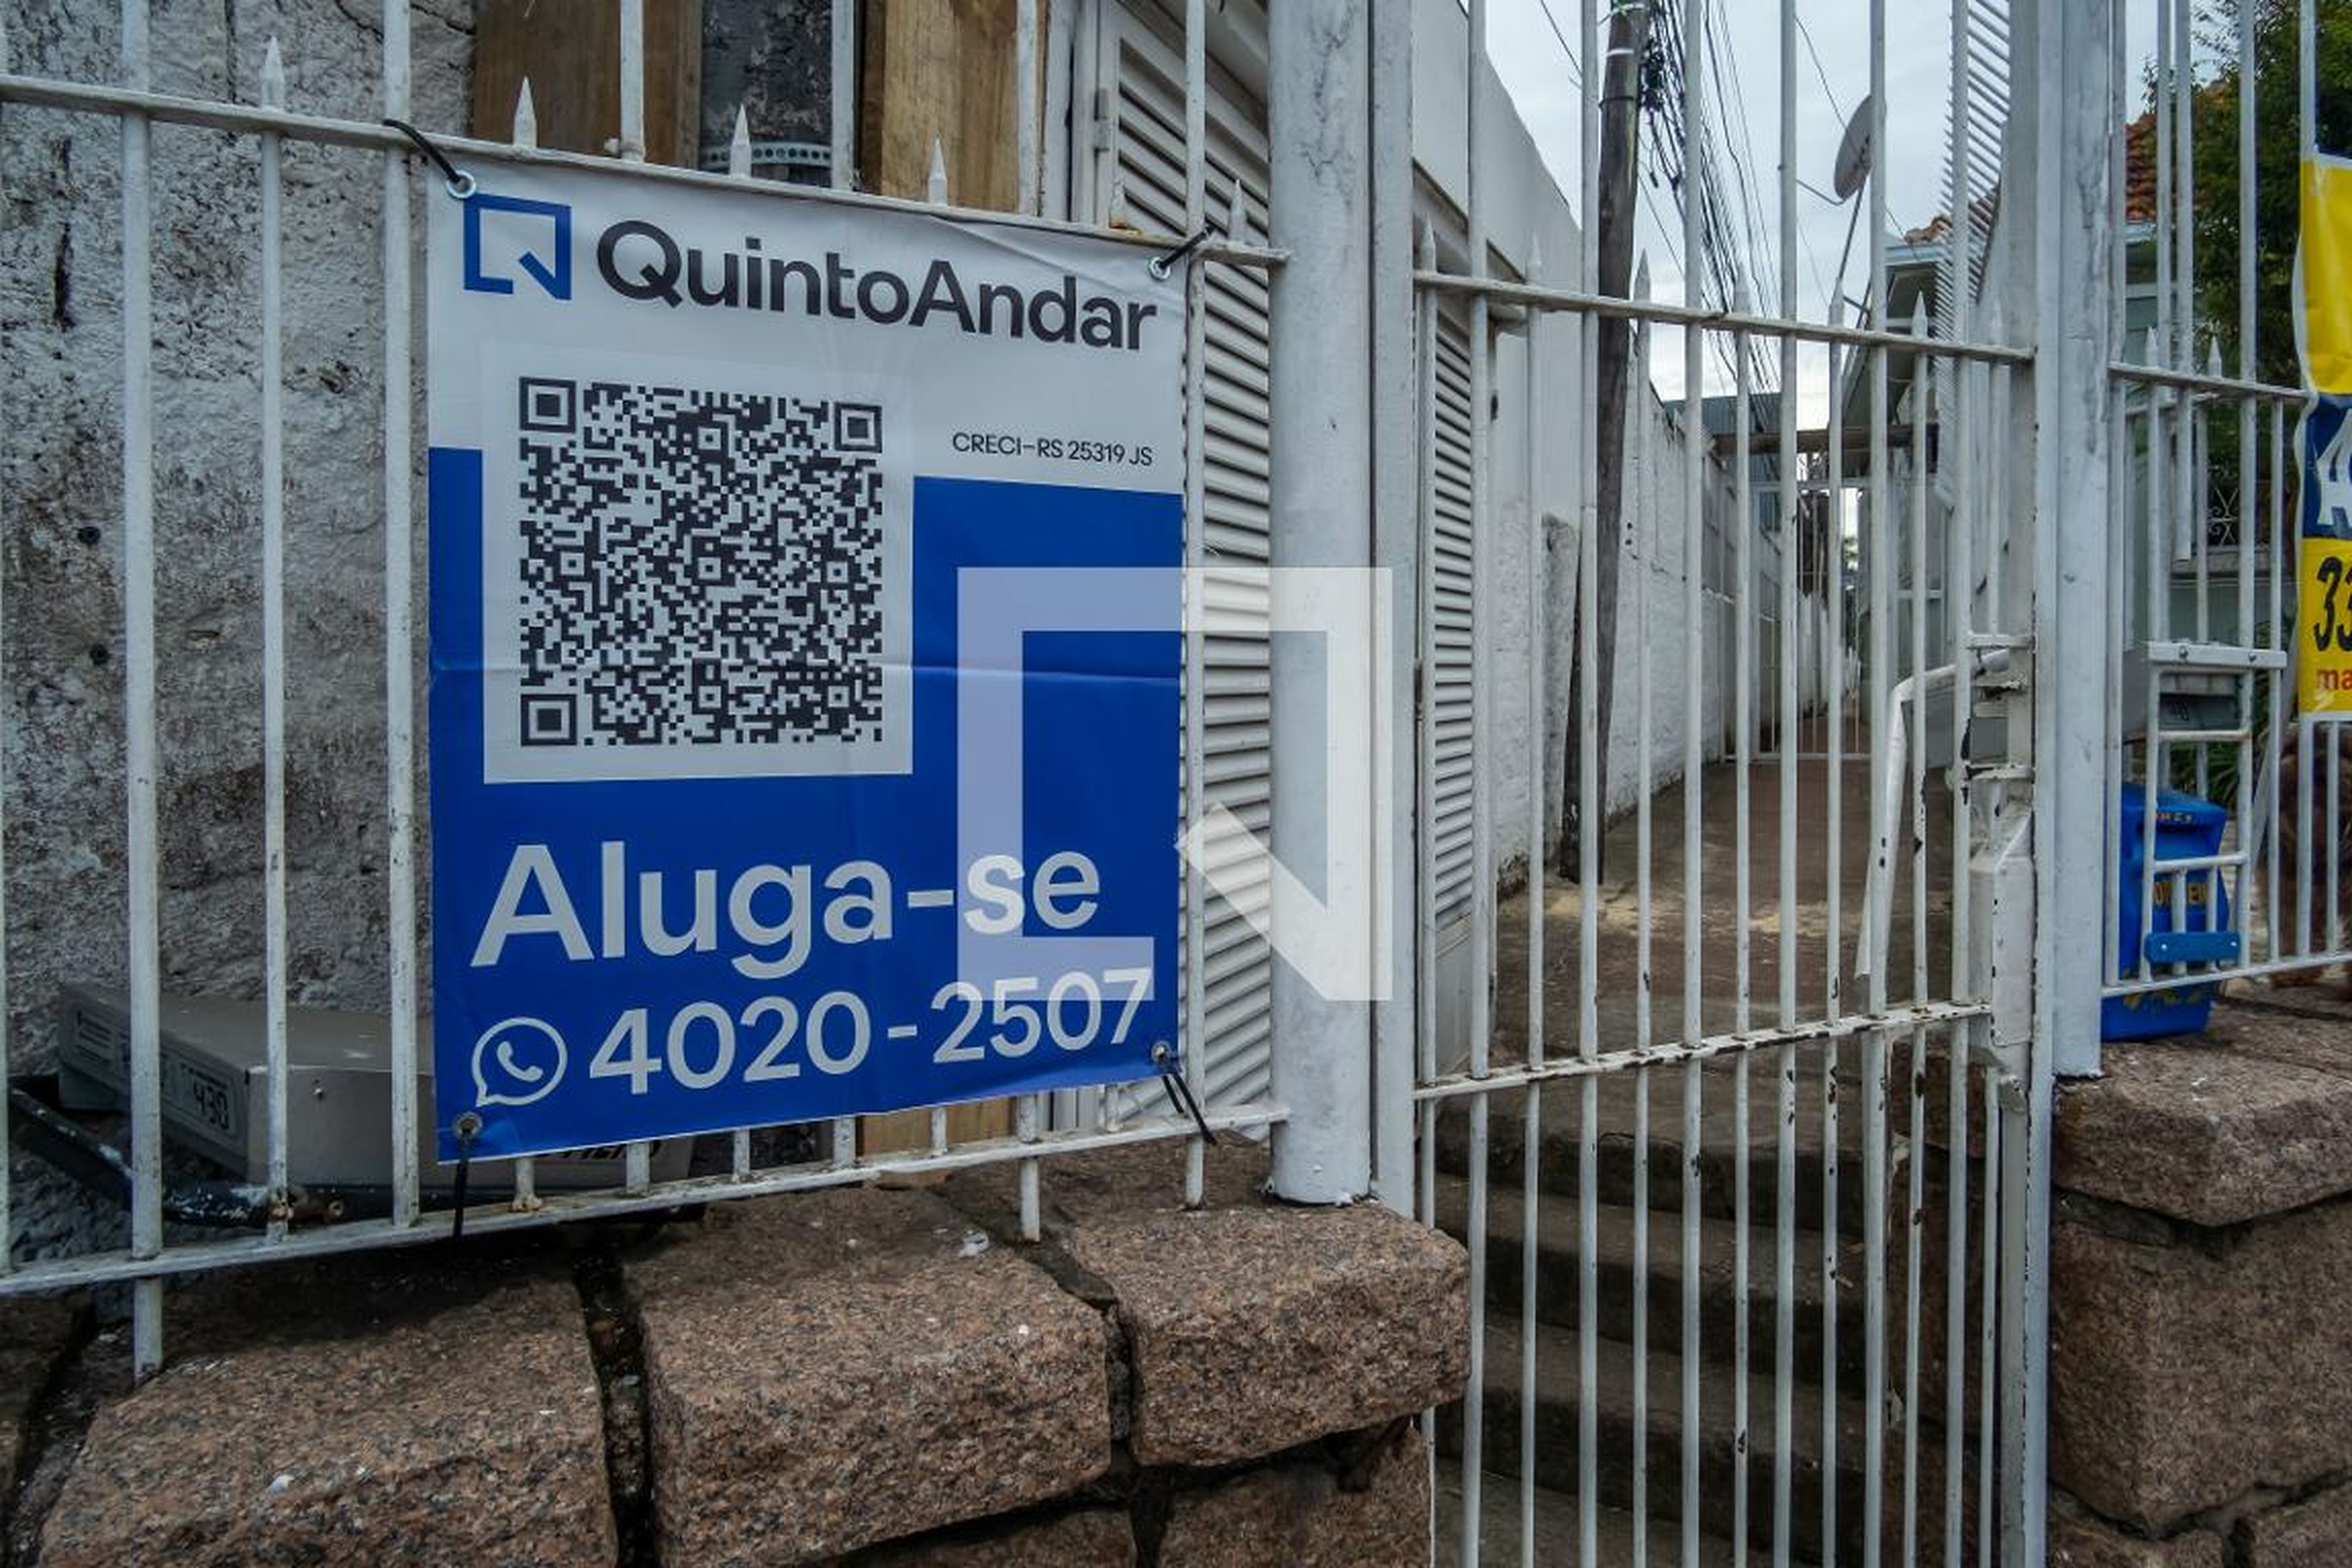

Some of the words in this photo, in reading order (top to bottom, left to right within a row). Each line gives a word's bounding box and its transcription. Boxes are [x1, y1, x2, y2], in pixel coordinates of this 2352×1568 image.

[595, 219, 1158, 350] QuintoAndar
[952, 431, 1064, 458] CRECI-RS
[1067, 440, 1126, 463] 25319
[1128, 446, 1154, 466] JS
[469, 840, 1100, 980] Aluga-se
